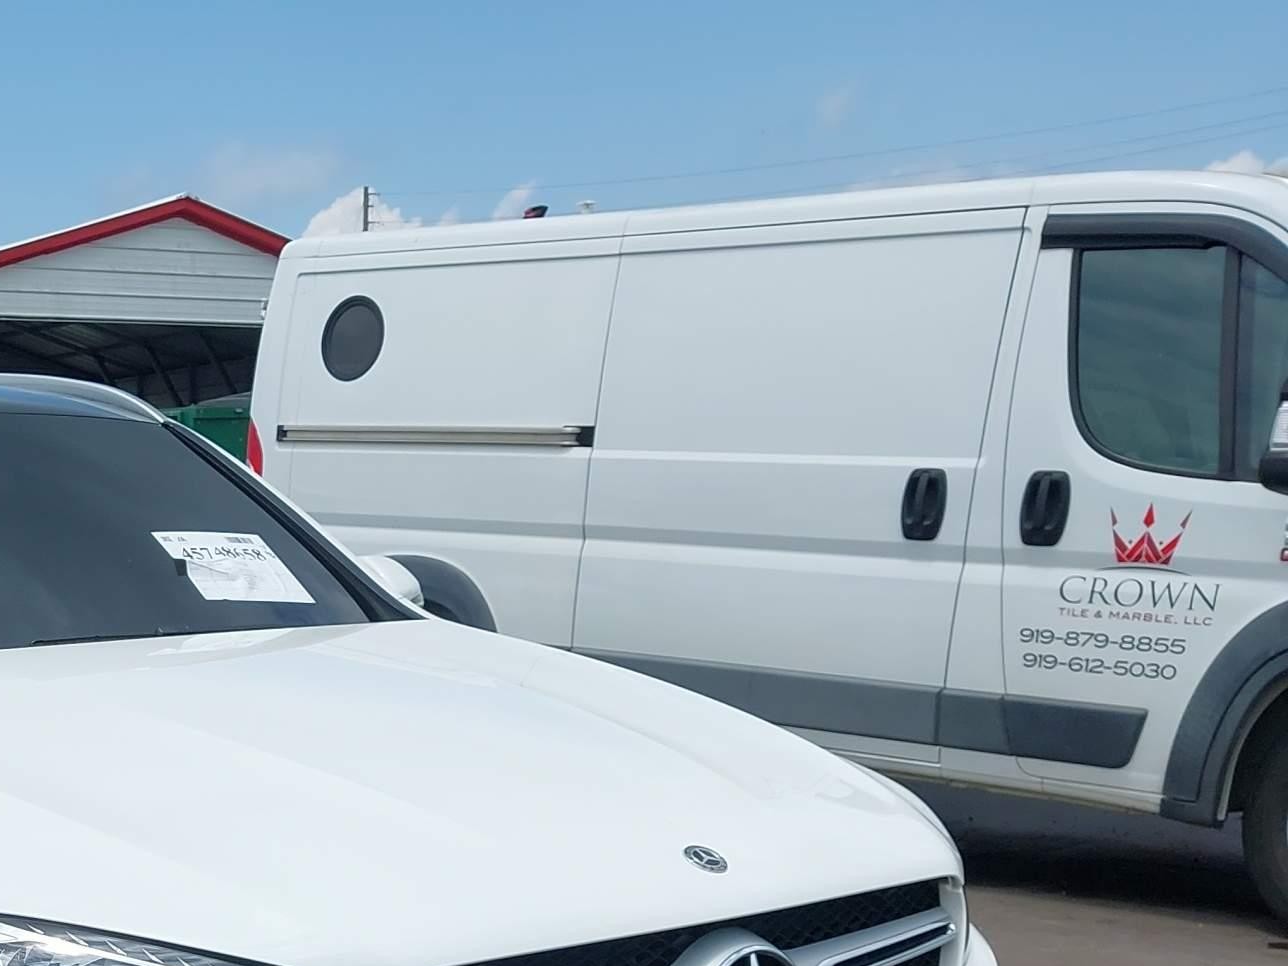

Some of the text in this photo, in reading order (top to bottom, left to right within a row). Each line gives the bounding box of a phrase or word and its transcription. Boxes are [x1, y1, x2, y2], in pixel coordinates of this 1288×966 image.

[1059, 576, 1221, 611] CROWN
[1058, 607, 1090, 619] TILE
[1094, 609, 1104, 620] &
[1184, 616, 1213, 626] LLC
[1020, 628, 1186, 655] 919-879-8855
[1023, 653, 1177, 680] 919-612-5030
